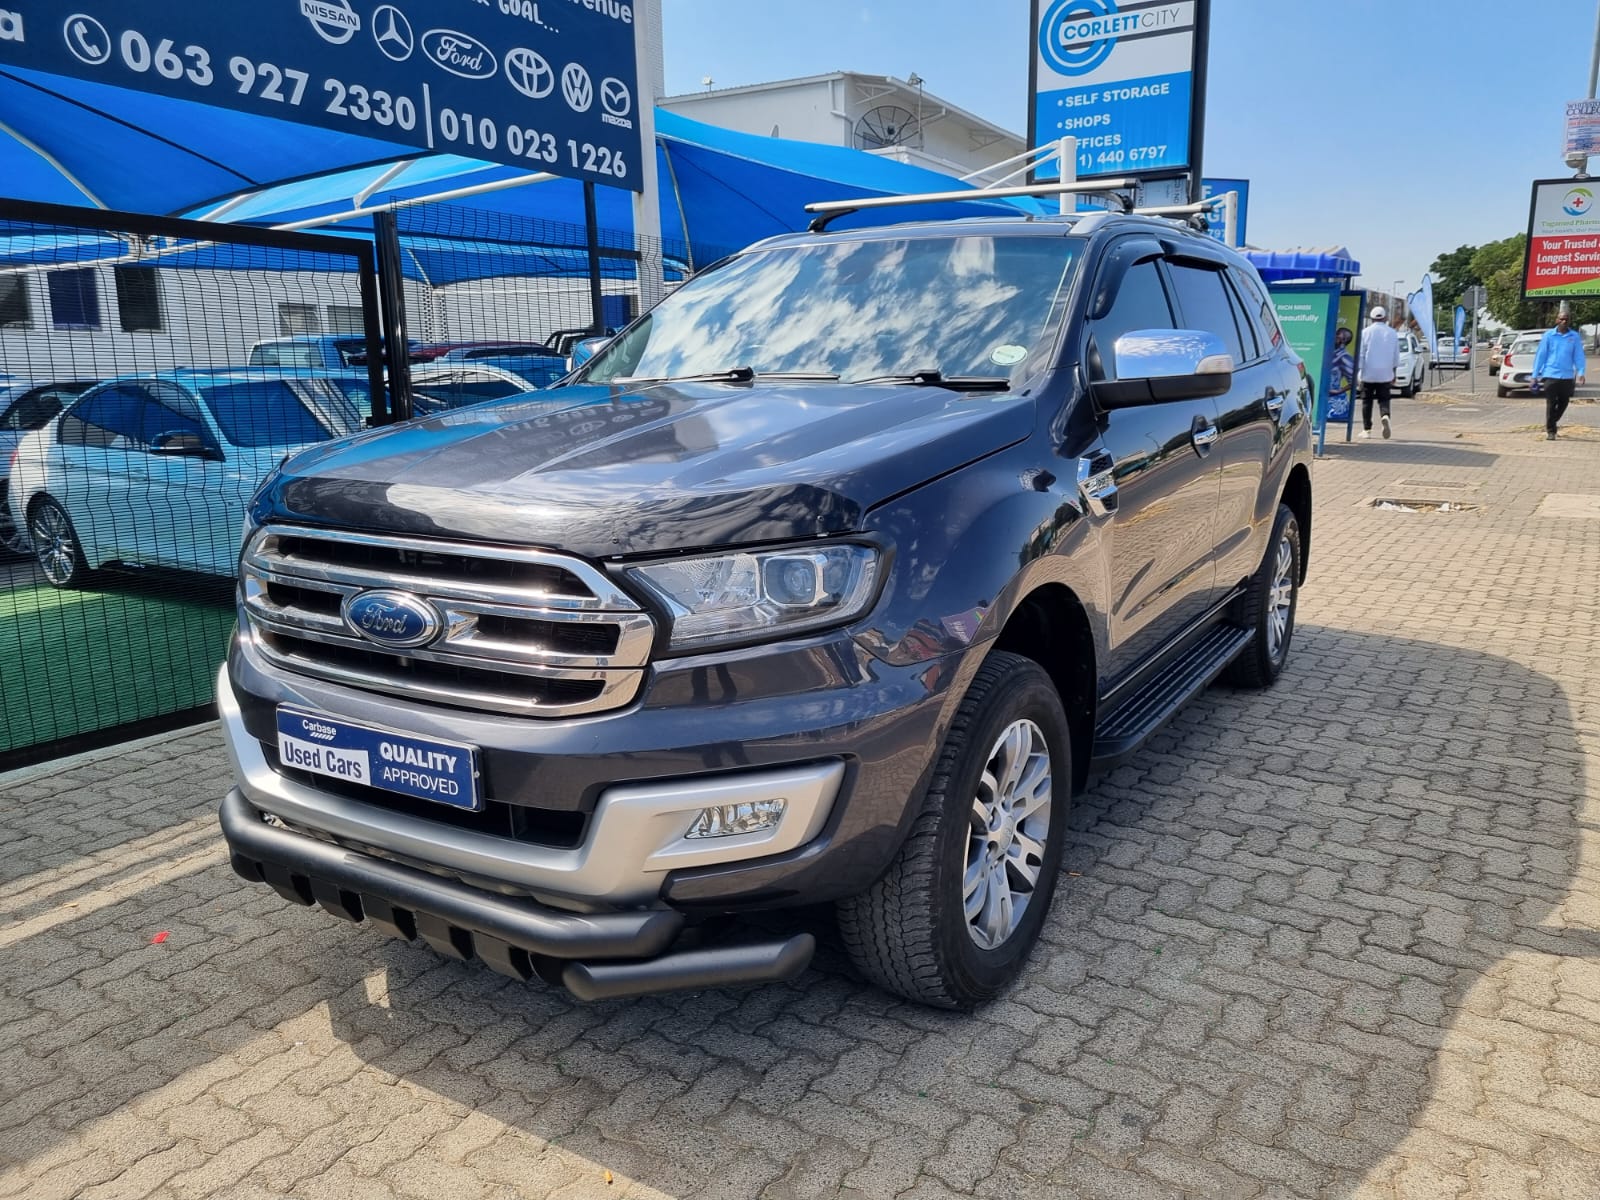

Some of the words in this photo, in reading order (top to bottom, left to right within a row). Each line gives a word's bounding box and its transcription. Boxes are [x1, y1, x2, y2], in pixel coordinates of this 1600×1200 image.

[304, 2, 358, 27] NISSAN
[436, 35, 484, 71] Ford
[120, 30, 214, 86] 063
[229, 56, 309, 106] 927
[324, 78, 416, 131] 2330
[440, 108, 498, 150] 010
[506, 125, 558, 163] 023
[566, 139, 627, 179] 1226
[1065, 92, 1099, 107] SELF
[1103, 82, 1170, 102] STORAGE
[1065, 113, 1111, 130] SHOPS
[1075, 134, 1122, 149] FFICES
[1097, 150, 1125, 164] 440
[1129, 145, 1168, 161] 6797
[1543, 240, 1562, 250] Your
[1564, 238, 1597, 249] Trusted
[1536, 266, 1560, 276] Local
[1537, 253, 1572, 265] Longest
[361, 603, 407, 634] Ford
[302, 719, 337, 736] Carbase
[284, 741, 321, 768] Used
[326, 752, 362, 779] Cars
[379, 742, 457, 774] QUALITY
[383, 766, 459, 796] APPROVED
